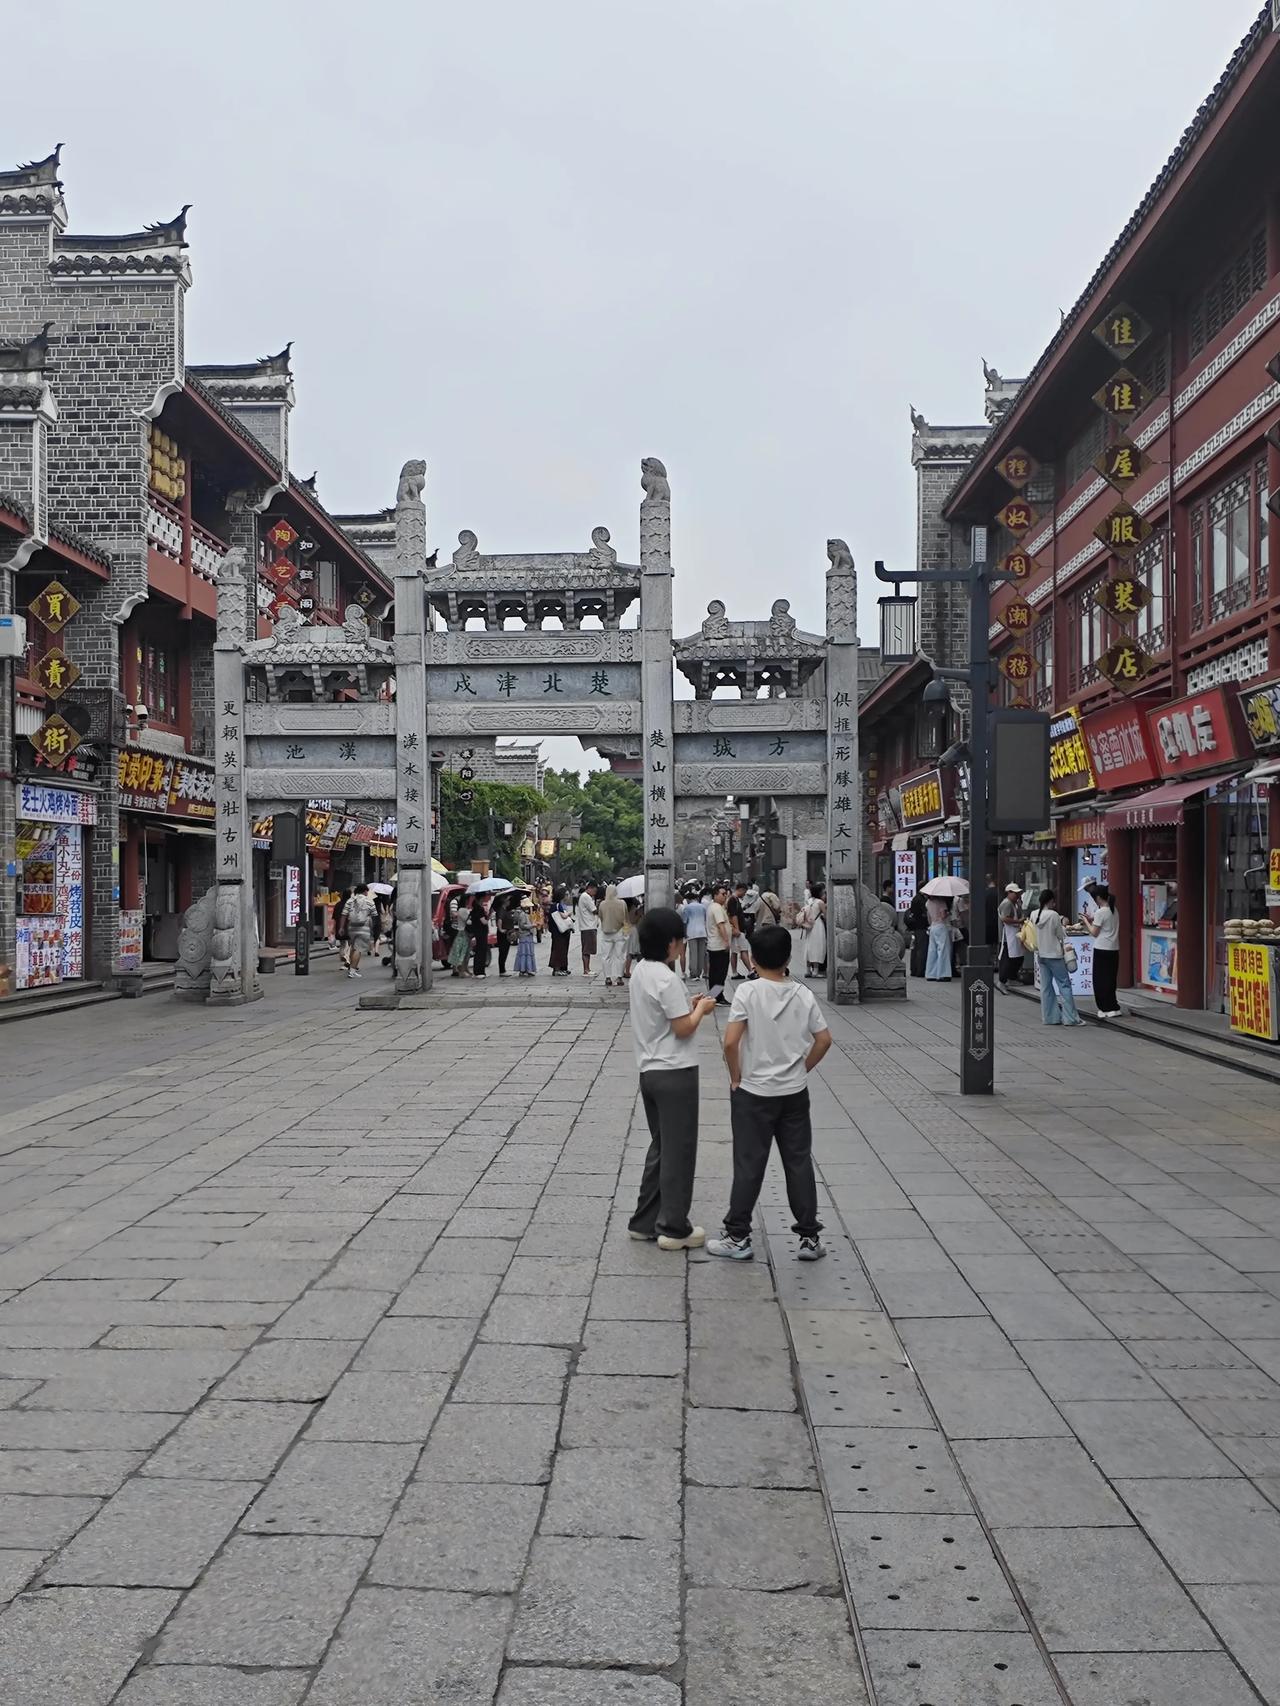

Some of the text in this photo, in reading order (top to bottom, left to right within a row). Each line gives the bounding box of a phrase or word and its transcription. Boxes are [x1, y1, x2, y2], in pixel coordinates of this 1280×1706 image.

[1110, 318, 1139, 677] 佳佳屋服装店
[1008, 458, 1029, 702] 狸奴国潮猫
[1097, 719, 1148, 771] 蜜雪冰城
[1080, 942, 1092, 989] 襄阳正宗
